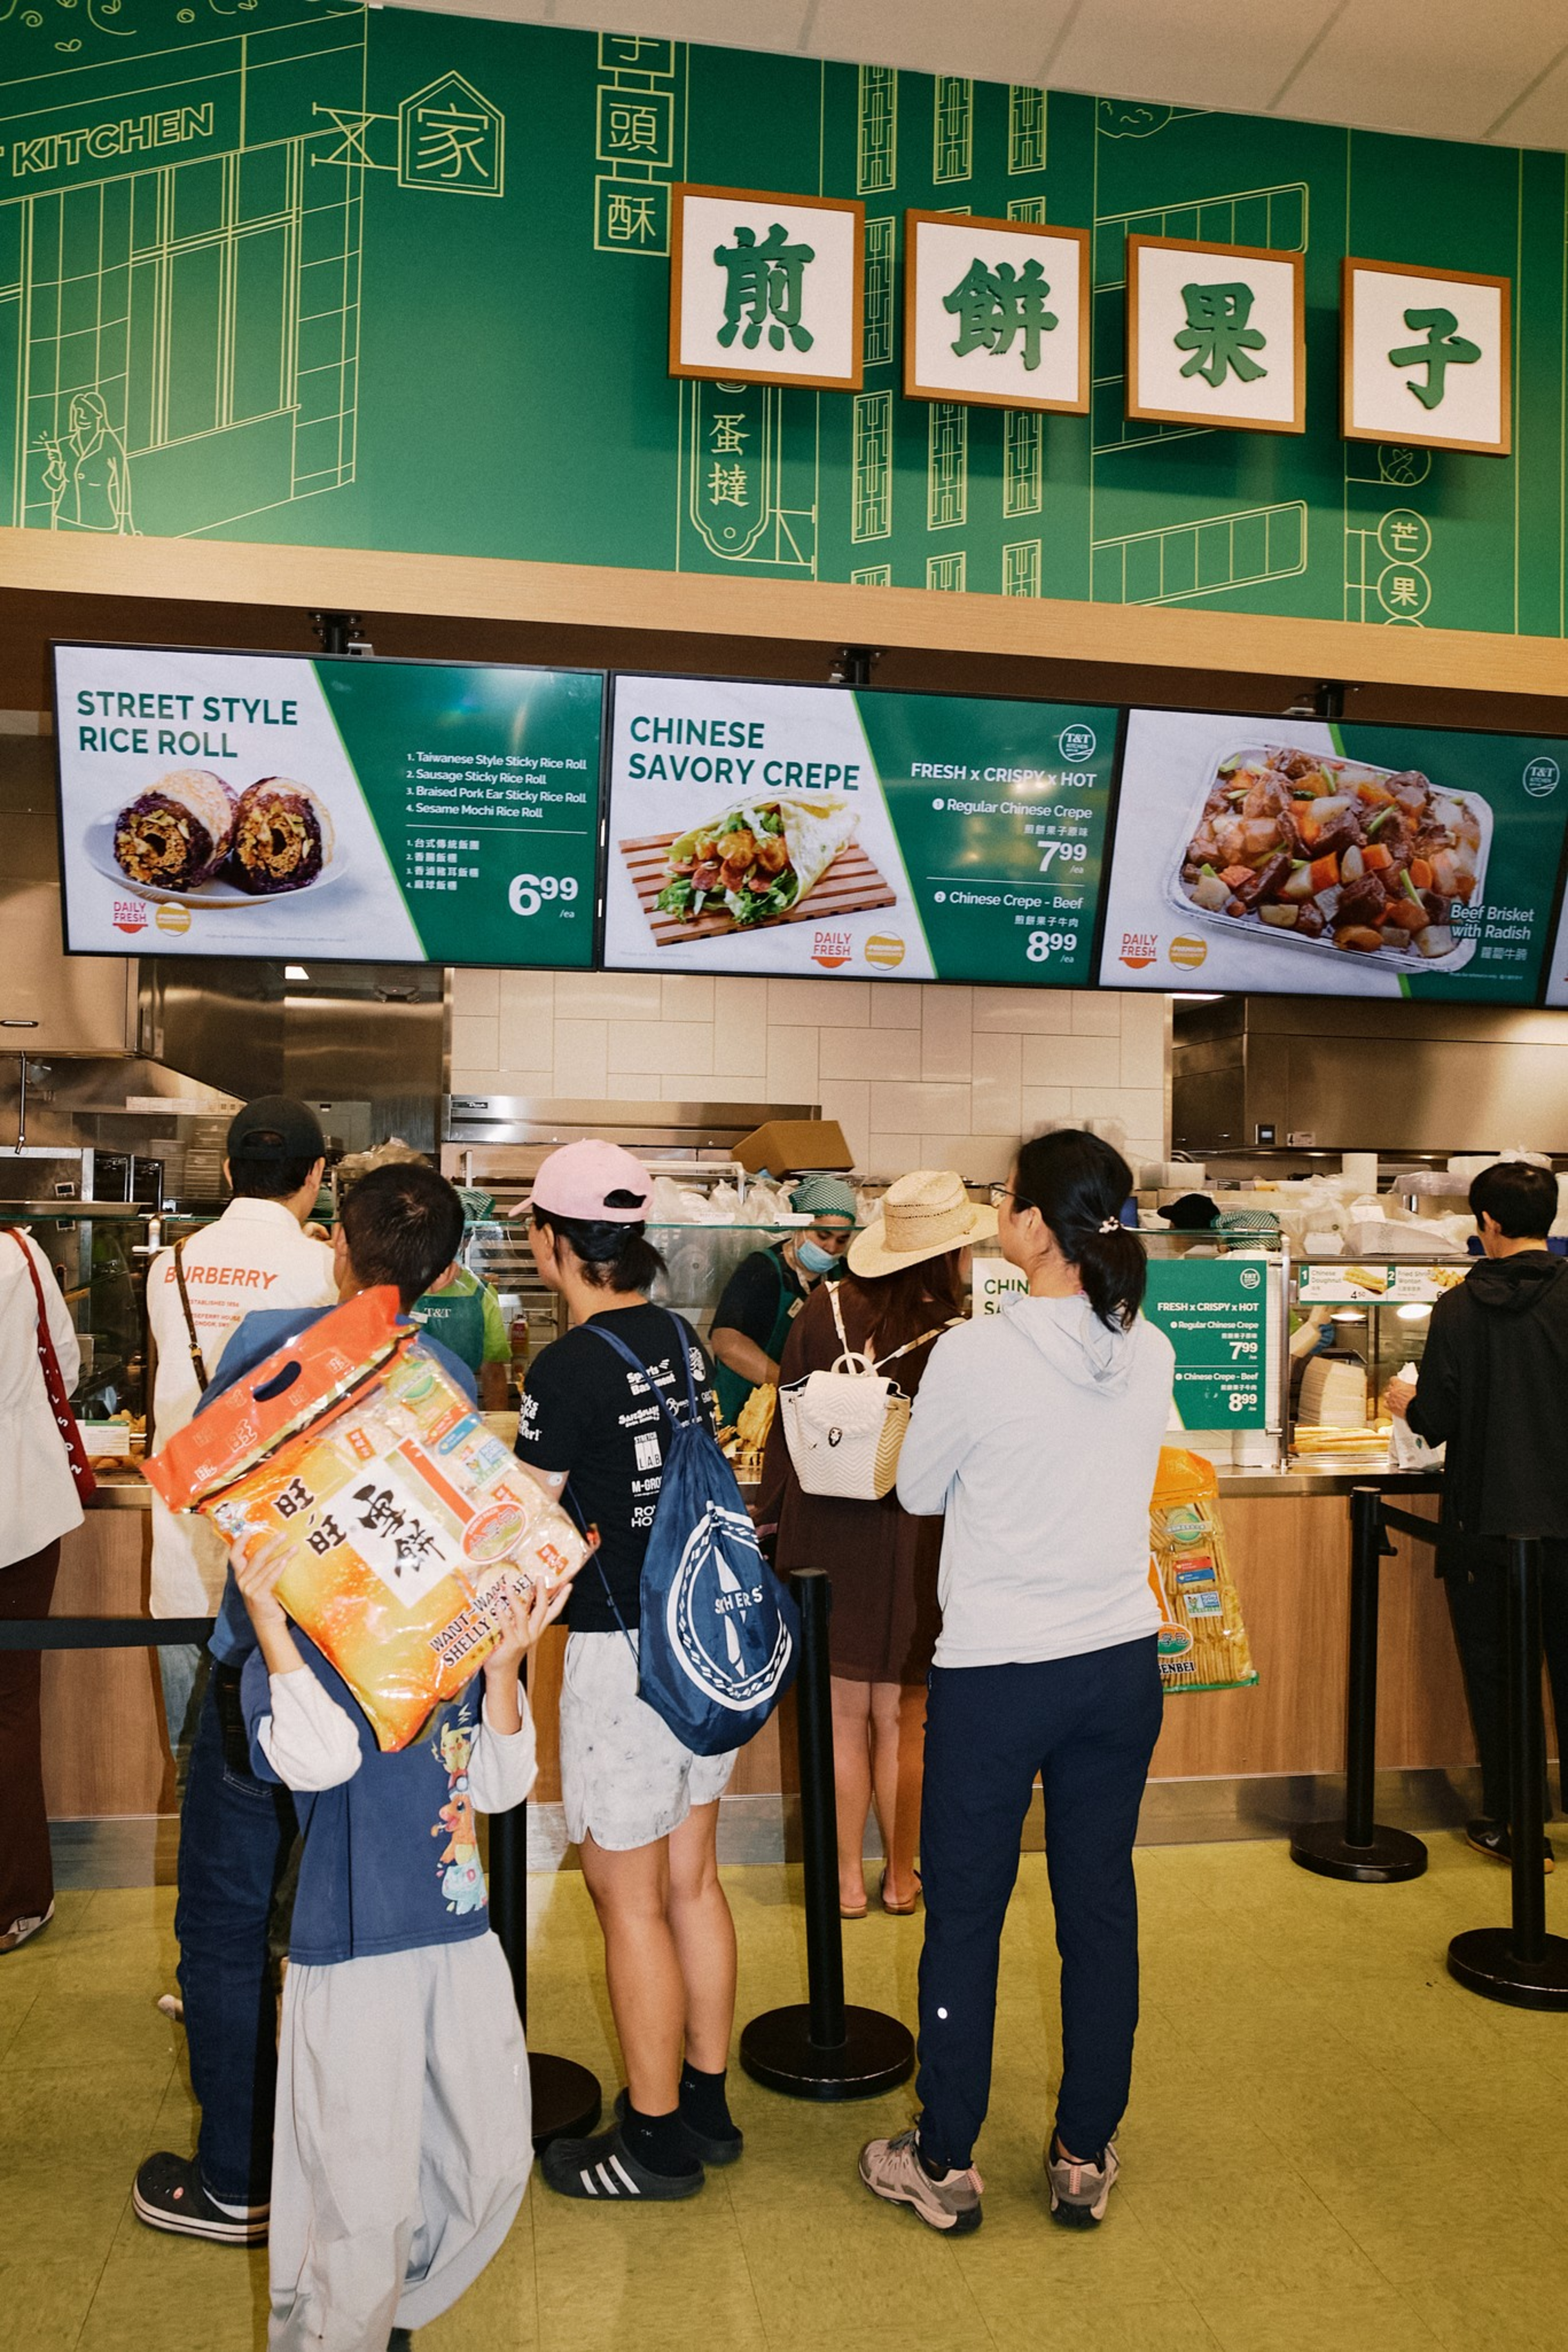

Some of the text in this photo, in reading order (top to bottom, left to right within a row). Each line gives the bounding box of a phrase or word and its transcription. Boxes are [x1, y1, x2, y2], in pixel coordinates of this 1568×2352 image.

[13, 103, 214, 176] KITCHEN
[417, 104, 489, 178] 家
[708, 413, 749, 508] 蛋撻
[1390, 522, 1419, 606] 芒果
[78, 691, 297, 725] STREET STYLE
[630, 716, 764, 749] CHINESE
[1065, 733, 1091, 743] T&T
[80, 727, 237, 758] RICE ROLL
[416, 752, 474, 764] Taiwanese
[476, 755, 503, 767] Style
[506, 756, 538, 769] Sticky
[540, 758, 563, 769] Rice
[566, 759, 587, 769] Roll
[416, 769, 463, 783] Sausage
[465, 771, 498, 784] Sticky
[499, 773, 523, 783] Rice
[525, 774, 546, 784] Roll
[629, 754, 860, 791] SAVORY CREPE
[911, 762, 967, 781] FRESH
[983, 766, 1045, 784] CRISPY
[1061, 772, 1097, 787] HOT
[1530, 766, 1556, 778] T&T
[416, 786, 457, 797] Braised
[459, 787, 484, 798] Pork
[486, 789, 503, 799] Ear
[506, 789, 538, 803] Sticky
[540, 791, 563, 802] Rice
[566, 792, 586, 803] Roll
[416, 803, 460, 814] Sesame
[461, 805, 494, 816] Mochi
[496, 806, 520, 816] Rice
[521, 807, 543, 818] Roll
[947, 799, 998, 814] Regular
[1000, 801, 1051, 816] Chinese
[1054, 805, 1092, 820] Crepe
[114, 902, 146, 913] DAILY
[949, 892, 1001, 906] Chinese
[1003, 894, 1042, 910] Crepe
[1053, 896, 1084, 909] Beef
[114, 913, 147, 923] FRESH
[559, 909, 575, 918] /ea
[1451, 905, 1535, 922] Beef Brisket
[815, 932, 851, 945] DAILY
[1123, 934, 1158, 946] DAILY
[1452, 924, 1531, 940] with Radish
[813, 945, 851, 956] FRESH
[1121, 945, 1156, 957] FRESH
[1302, 1270, 1307, 1280] 1
[1388, 1271, 1395, 1281] 2
[425, 1308, 451, 1318] T&T
[1158, 1303, 1189, 1311] FRESH
[1197, 1302, 1230, 1311] CRISPY
[1238, 1303, 1259, 1311] HOT
[1178, 1321, 1259, 1331] Regular Chinese Crepe
[630, 1373, 676, 1396] Basment
[1214, 1373, 1236, 1382] Crepe
[639, 1453, 661, 1469] LAB
[632, 1477, 662, 1494] M-GRO
[635, 1506, 656, 1518] RO
[443, 1617, 490, 1666] SHELLY
